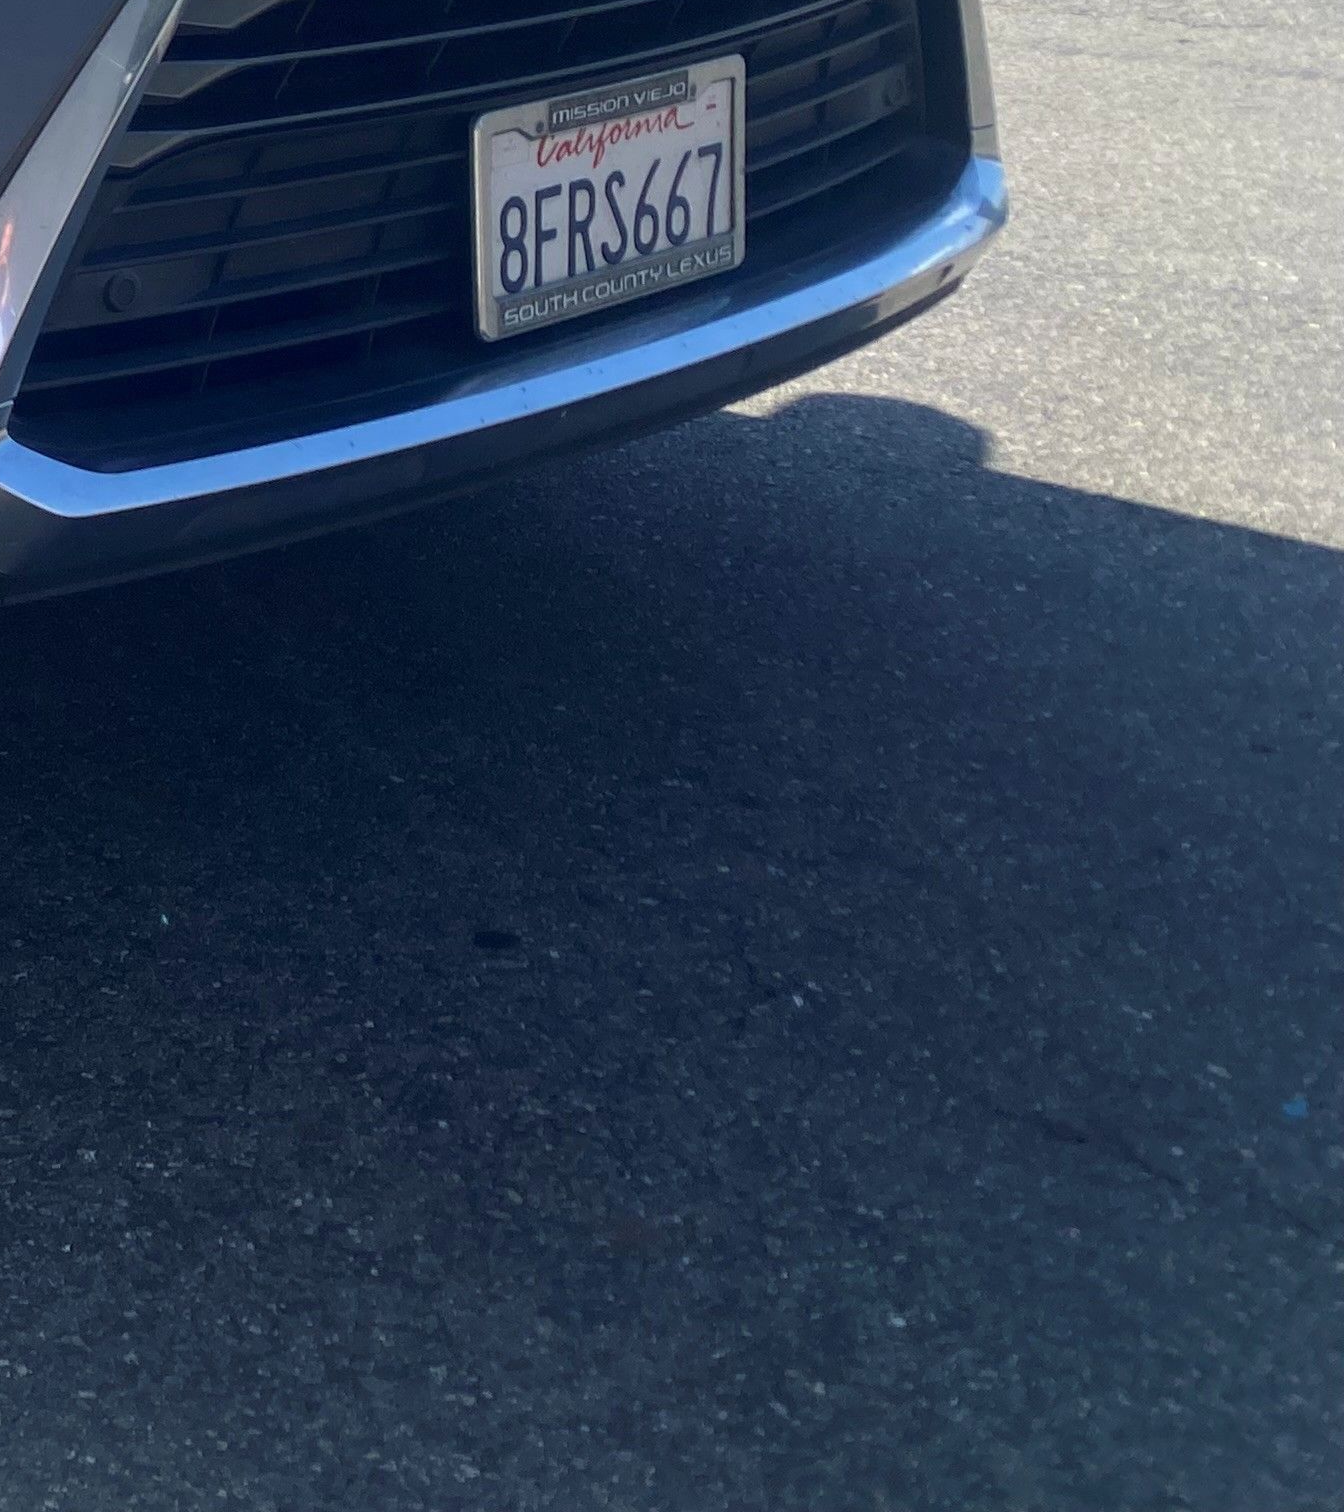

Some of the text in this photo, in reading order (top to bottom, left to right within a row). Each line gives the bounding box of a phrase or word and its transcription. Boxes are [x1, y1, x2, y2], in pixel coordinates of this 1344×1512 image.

[536, 105, 695, 168] California
[552, 94, 629, 125] MISSION
[633, 81, 686, 105] VIEJO
[499, 142, 723, 294] 8FRS667
[504, 245, 732, 326] SOUTH COUNTY LEXUS
